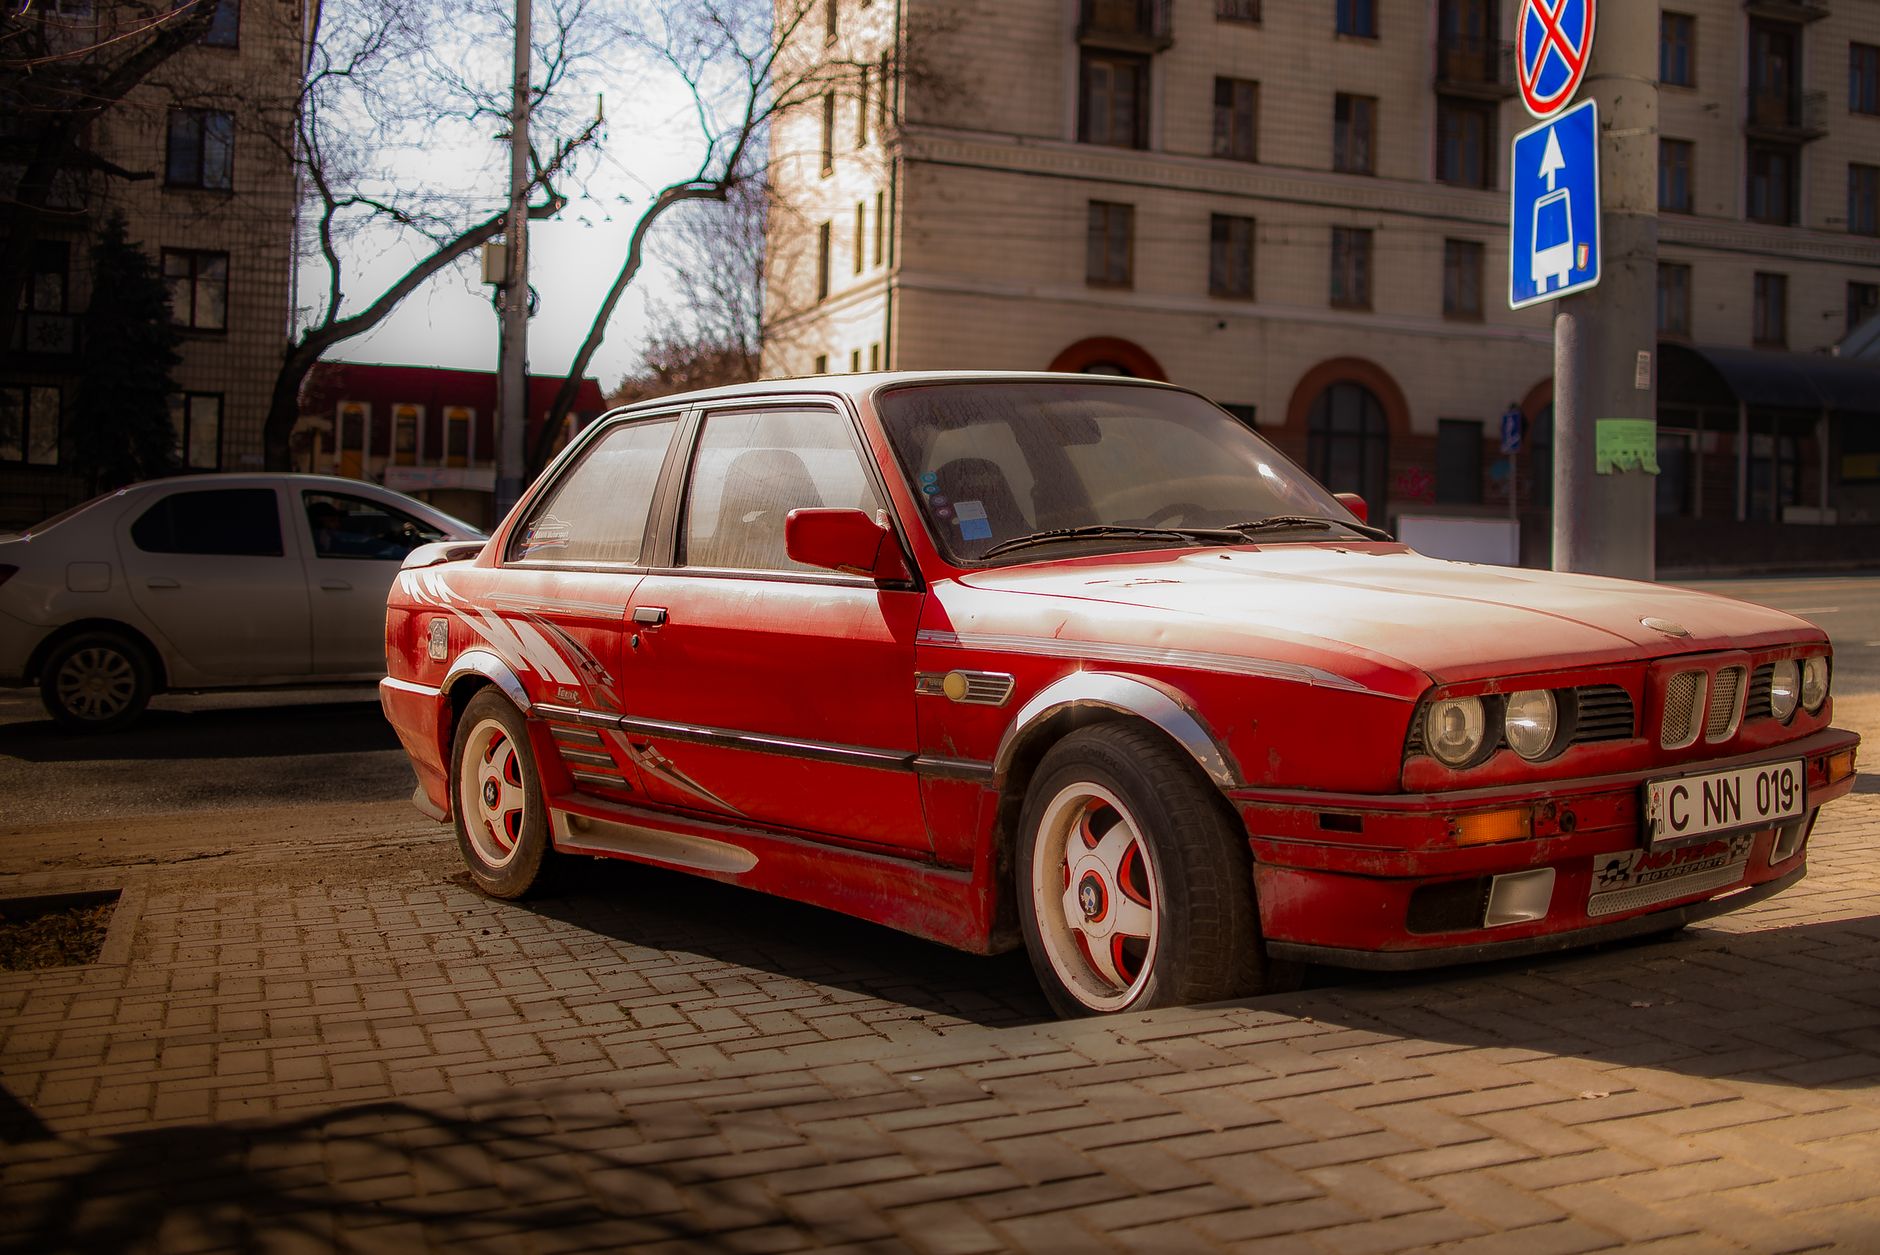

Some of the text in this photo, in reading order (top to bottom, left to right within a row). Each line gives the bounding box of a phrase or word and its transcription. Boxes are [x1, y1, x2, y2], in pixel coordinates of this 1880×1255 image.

[1669, 767, 1794, 832] C NN 019
